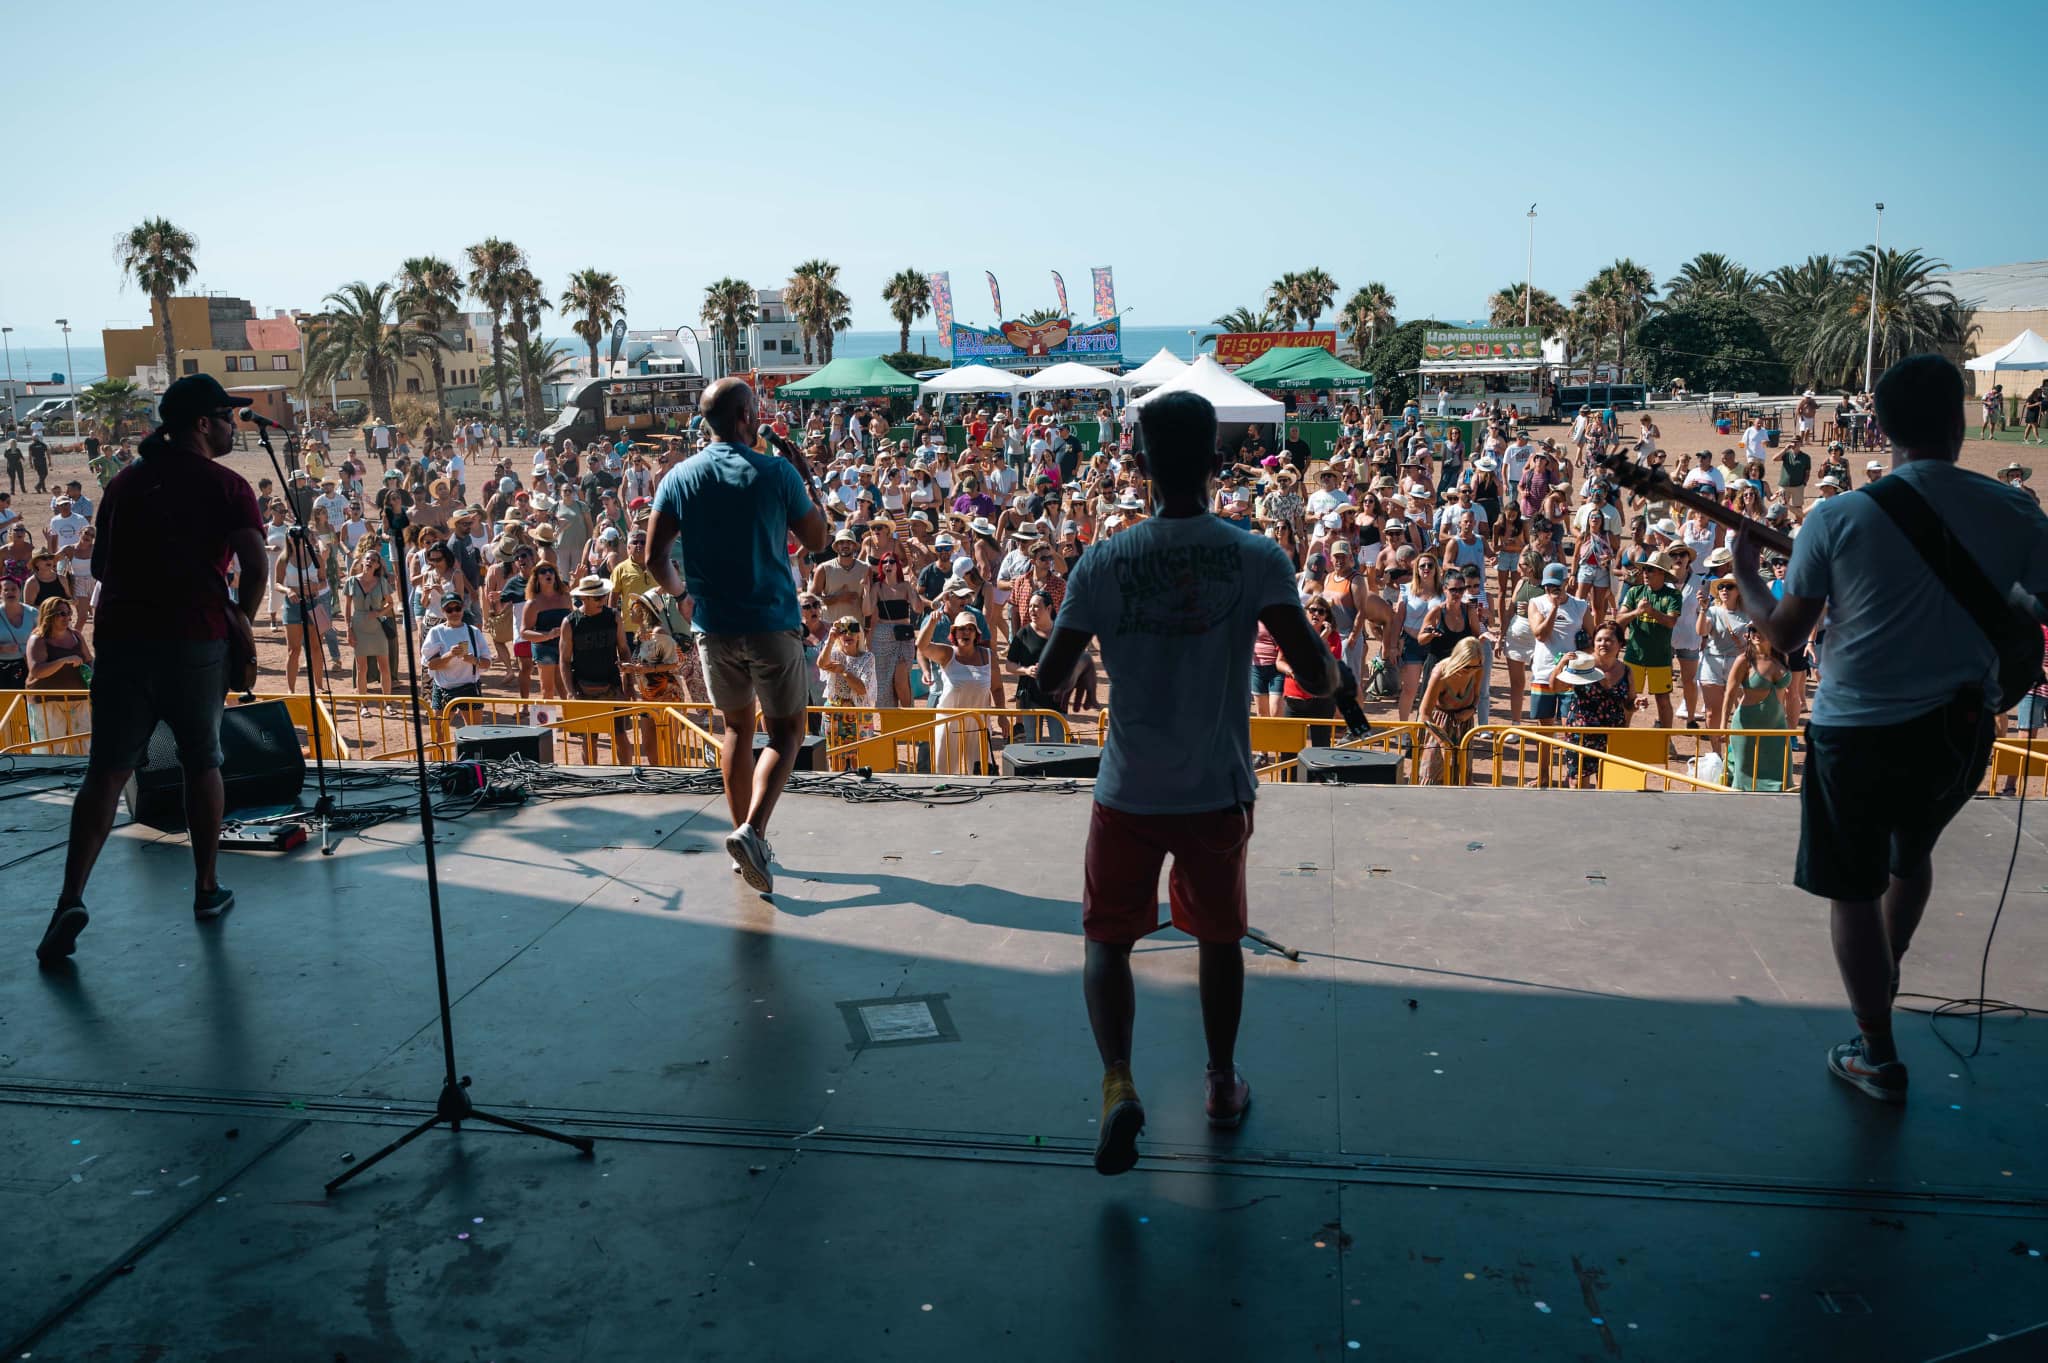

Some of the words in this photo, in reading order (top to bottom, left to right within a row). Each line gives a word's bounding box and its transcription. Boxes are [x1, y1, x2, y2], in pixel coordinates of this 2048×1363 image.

[1067, 334, 1117, 351] PEPITO
[1286, 380, 1311, 388] Tropical
[1342, 377, 1366, 387] Tropical
[839, 388, 861, 396] Tropical
[890, 386, 912, 394] Tropical
